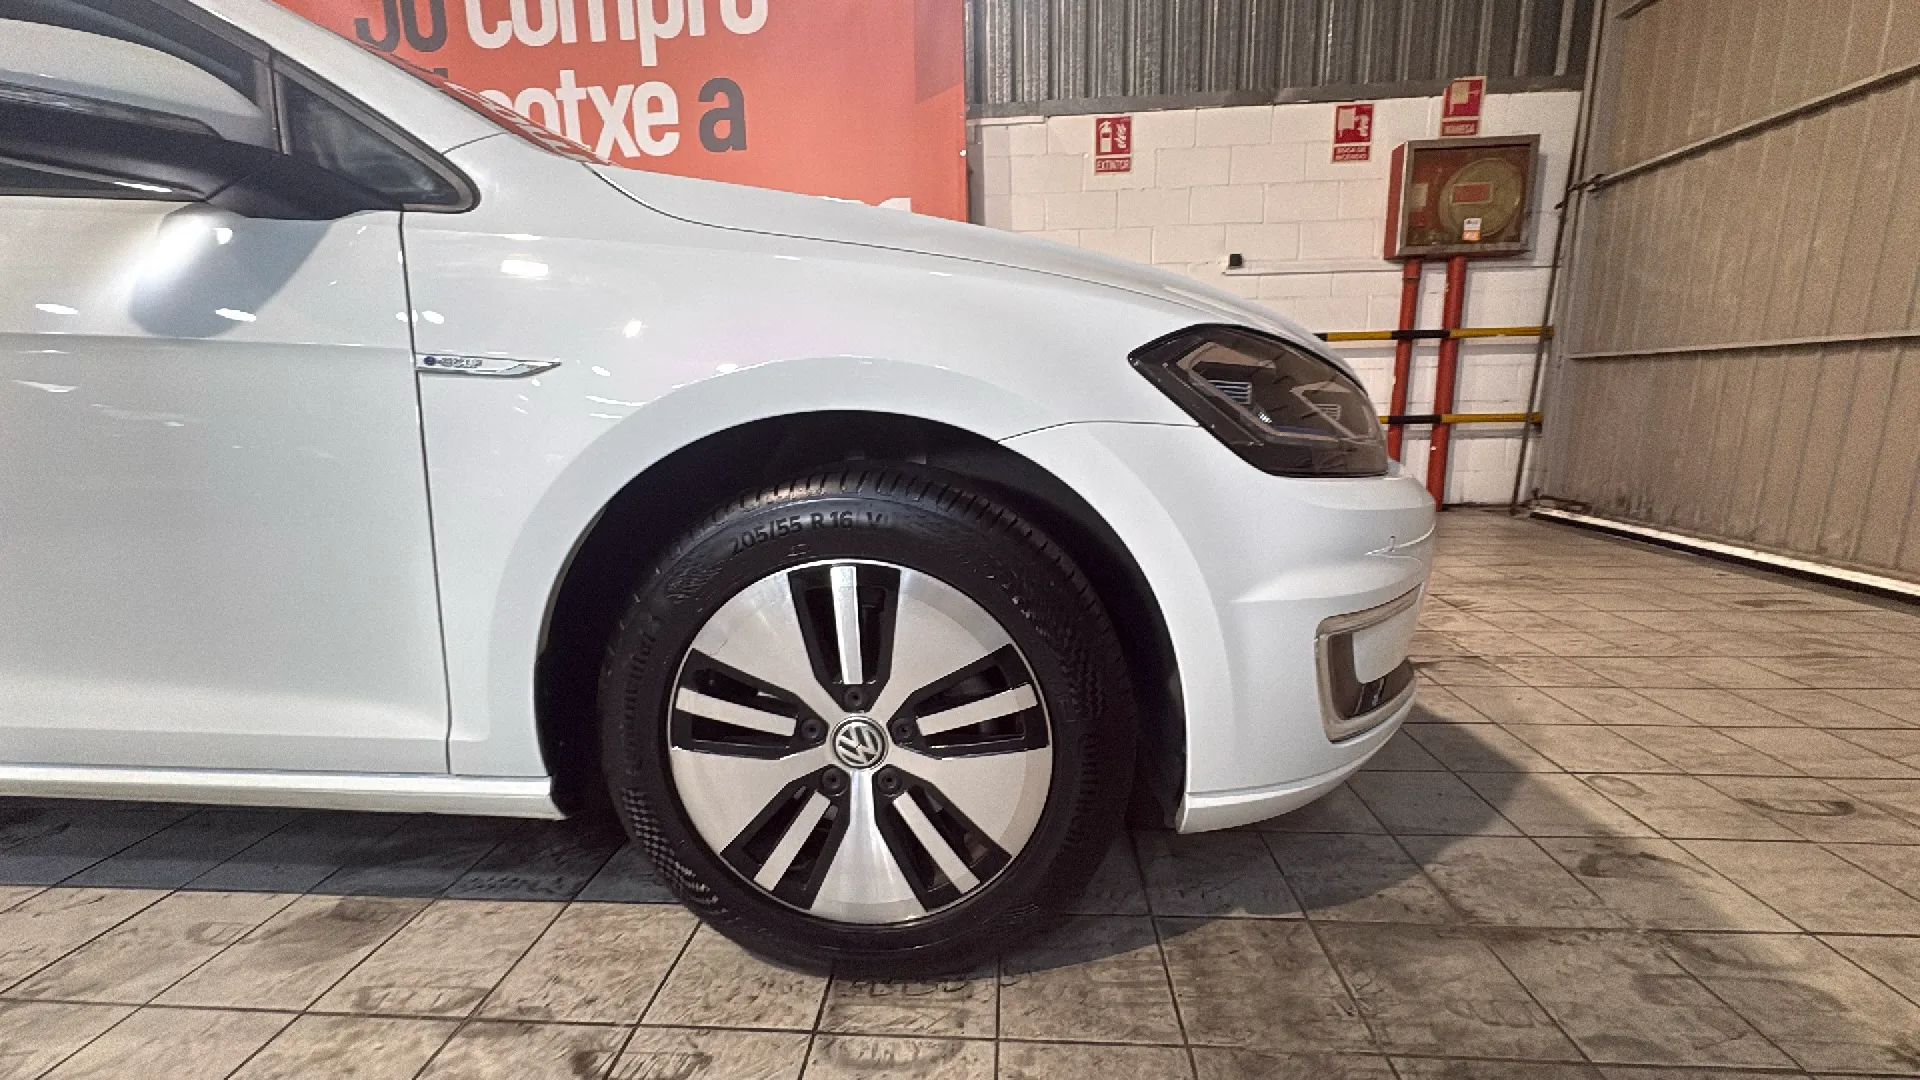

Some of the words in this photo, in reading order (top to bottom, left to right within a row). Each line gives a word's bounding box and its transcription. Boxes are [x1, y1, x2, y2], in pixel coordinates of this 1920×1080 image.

[479, 69, 680, 157] otxe
[698, 77, 747, 152] a
[731, 515, 803, 555] 205/55
